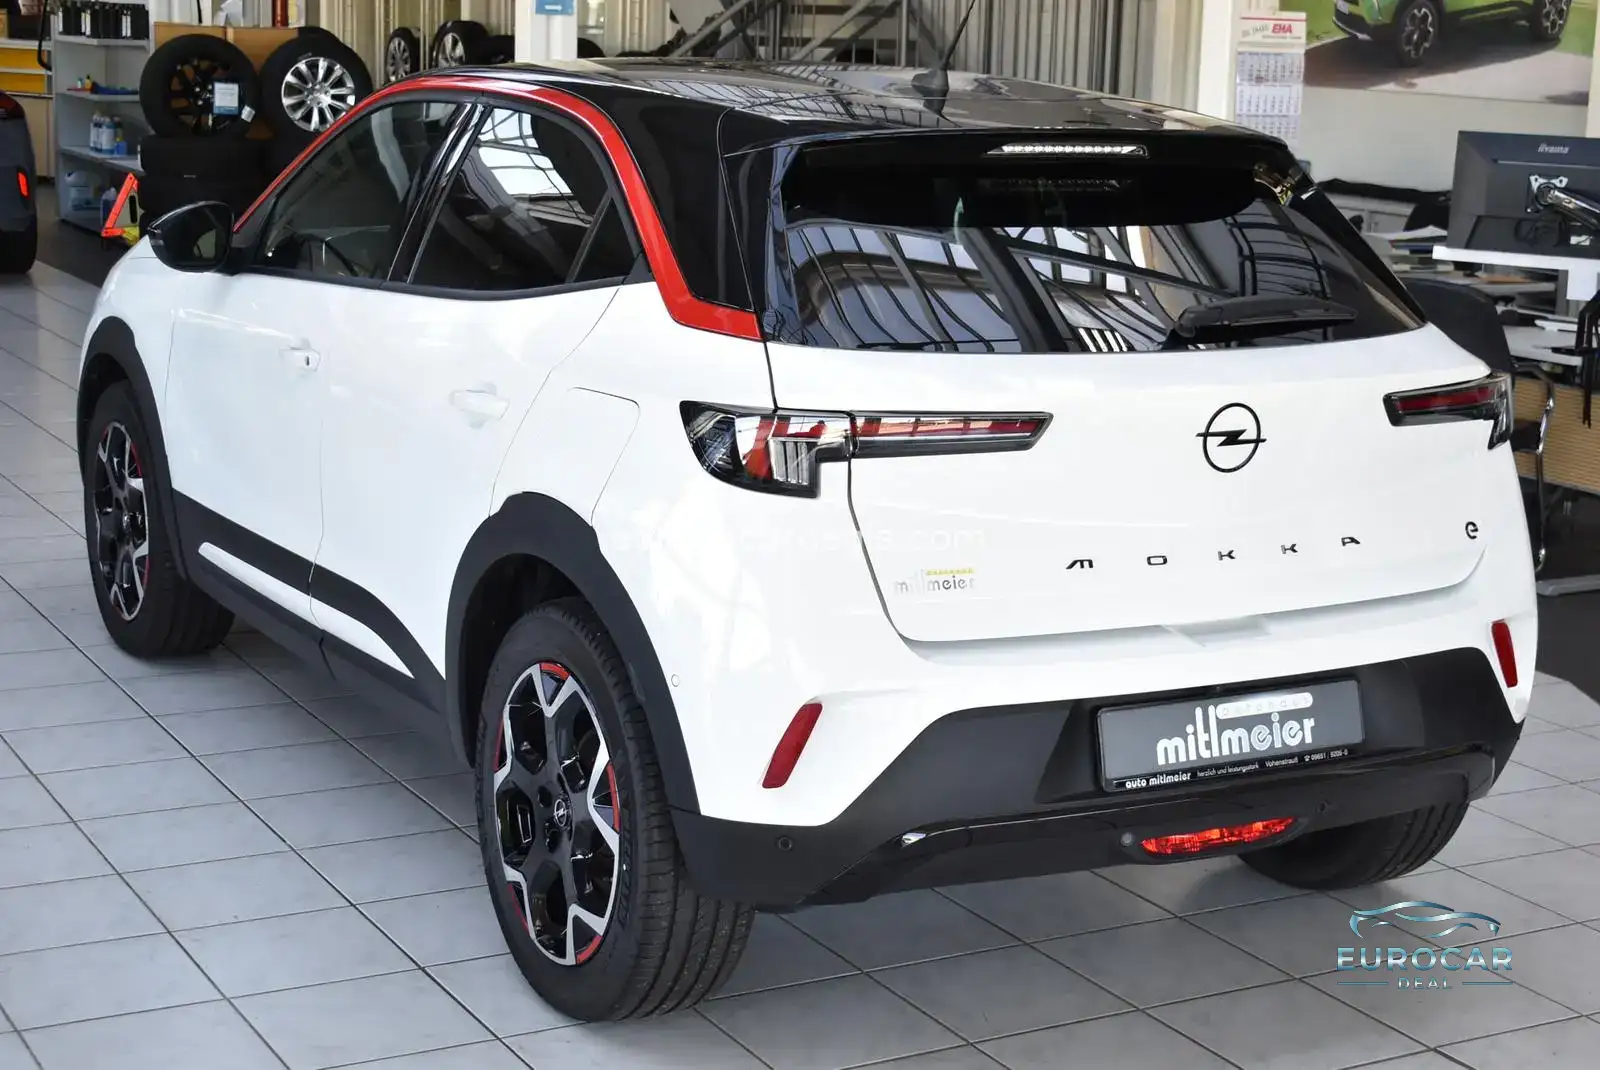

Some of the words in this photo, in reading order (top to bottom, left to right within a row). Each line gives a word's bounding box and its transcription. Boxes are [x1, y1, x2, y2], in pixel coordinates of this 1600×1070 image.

[1271, 23, 1293, 34] EHA
[1066, 536, 1361, 570] MOKKA
[1156, 704, 1315, 766] mitlmeier
[1125, 778, 1147, 789] auto
[1149, 771, 1192, 786] mitlmeier
[1217, 765, 1227, 775] und
